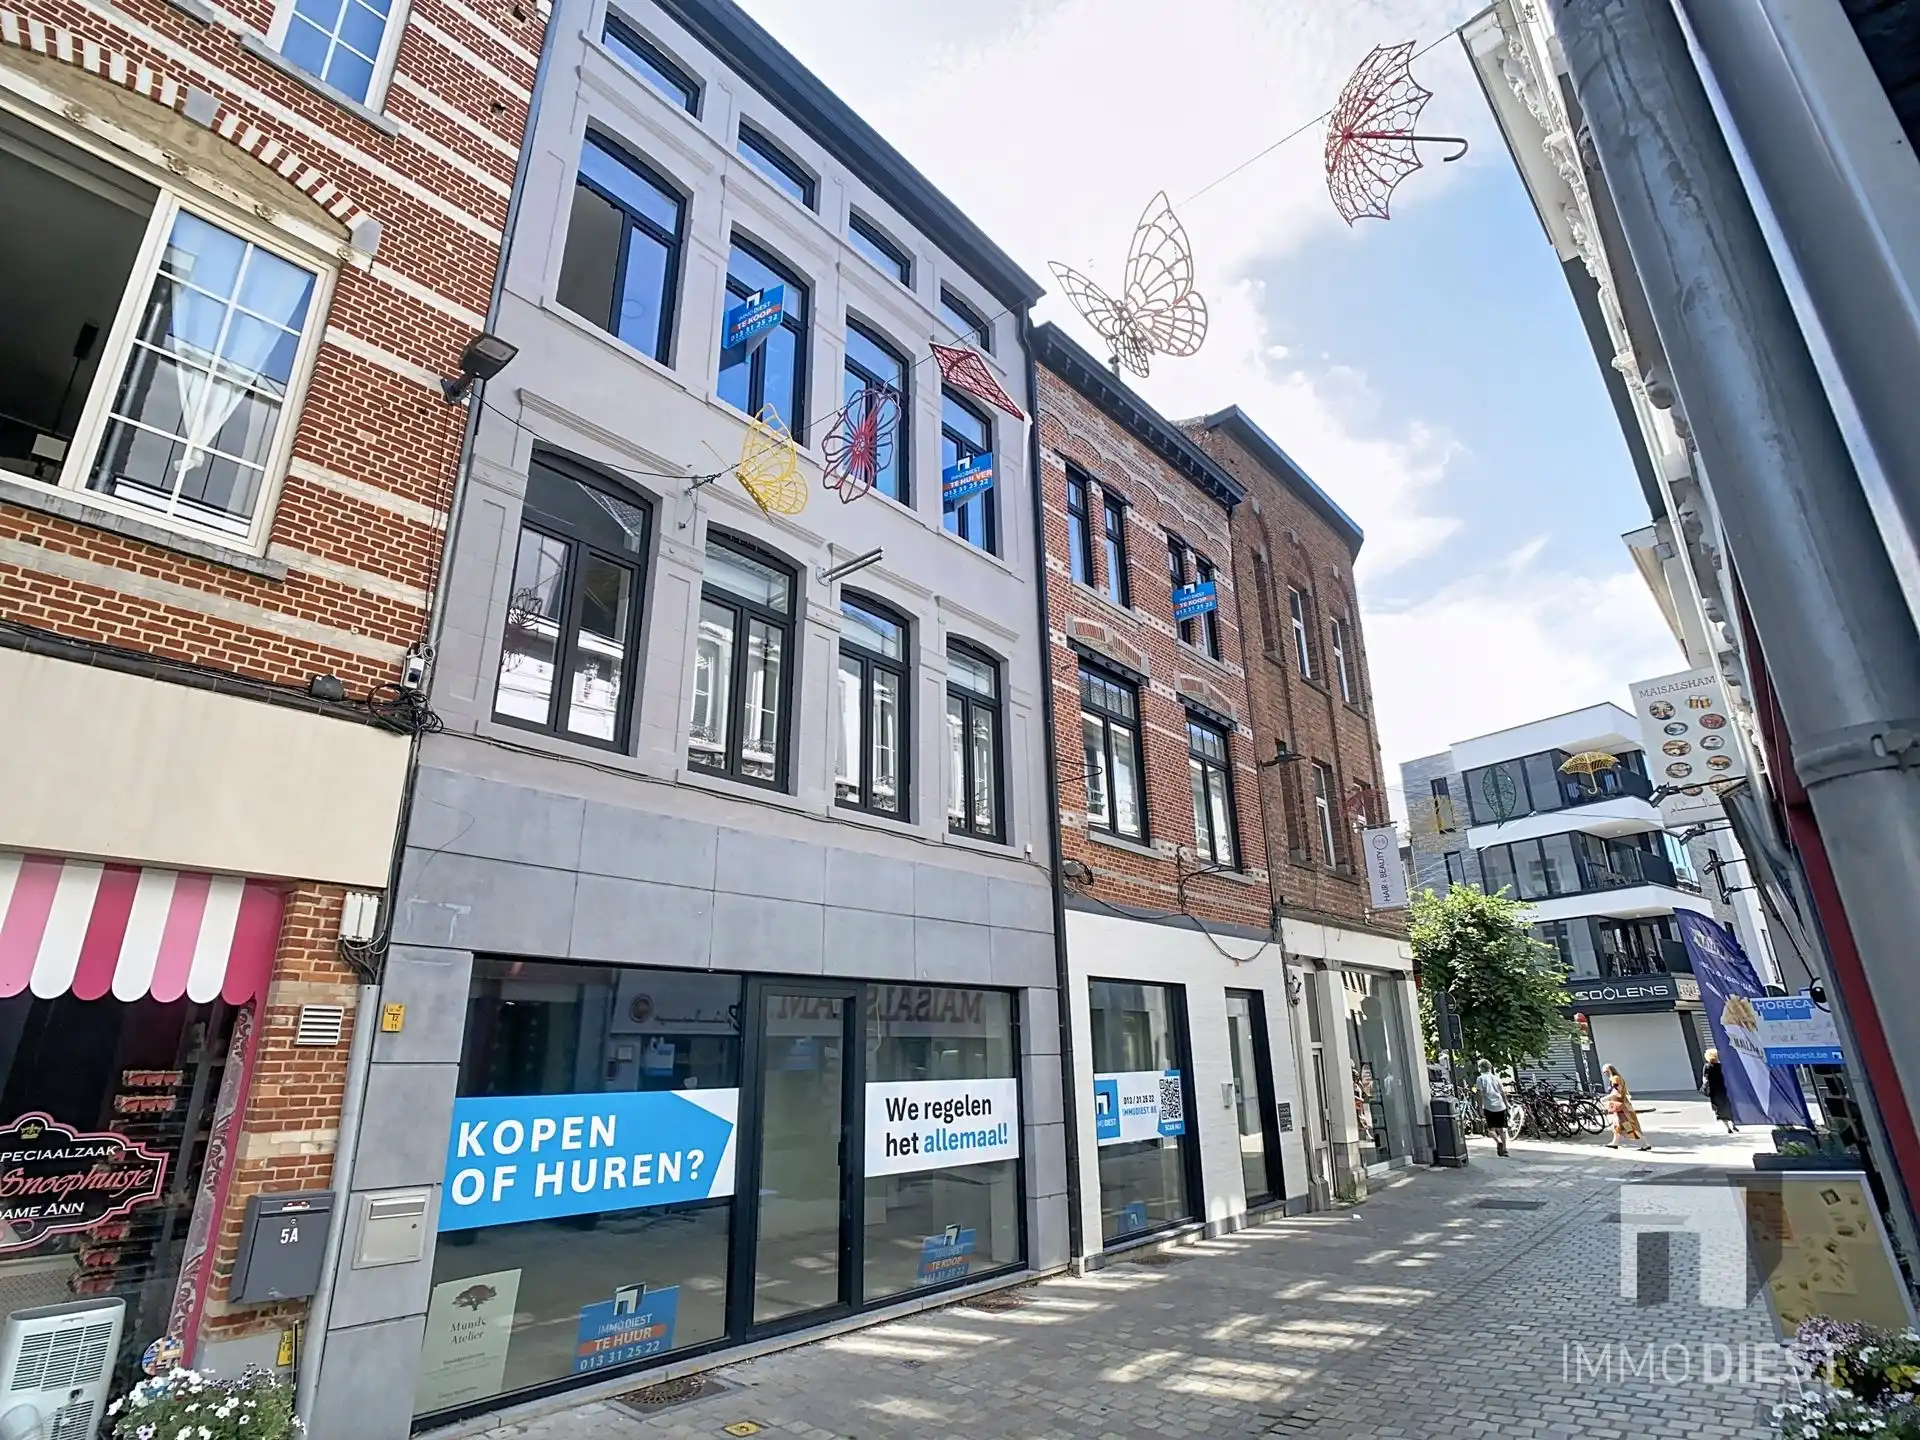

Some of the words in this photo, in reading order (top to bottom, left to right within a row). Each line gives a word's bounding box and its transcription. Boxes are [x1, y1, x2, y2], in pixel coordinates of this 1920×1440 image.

[731, 331, 743, 341] 013
[756, 318, 766, 328] 25
[768, 313, 778, 322] 22
[737, 320, 747, 330] TE
[748, 308, 772, 324] KOOP
[944, 489, 957, 497] 013
[980, 478, 989, 486] 22
[950, 480, 959, 488] TE
[1188, 596, 1206, 605] KOOP
[1639, 675, 1717, 699] MAISALSHAM
[1376, 851, 1387, 878] BEAUTY
[1381, 884, 1391, 902] HAIR
[1756, 999, 1813, 1010] HORECA
[1770, 1051, 1828, 1060] immodiest.be
[885, 1097, 919, 1122] We
[924, 1094, 992, 1124] regelen
[1123, 1096, 1133, 1105] 013
[1136, 1095, 1142, 1104] 31
[1142, 1095, 1148, 1103] 25
[1148, 1094, 1155, 1103] 22
[456, 1114, 617, 1158] KOPEN
[886, 1132, 919, 1157] het
[923, 1122, 1008, 1153] allemaal!
[0, 1163, 153, 1202] Snoephuisje
[451, 1164, 517, 1206] OF
[534, 1149, 705, 1198] HUREN?
[44, 1202, 85, 1217] ANN
[280, 1227, 299, 1244] 5A
[942, 1256, 962, 1268] KOOP
[625, 1313, 653, 1328] DIEST
[450, 1331, 484, 1345] Atelier
[595, 1337, 611, 1351] TE
[613, 1327, 652, 1347] HUUR
[580, 1355, 604, 1370] 013
[608, 1350, 622, 1363] 31
[627, 1346, 641, 1358] 25
[645, 1341, 660, 1353] 22
